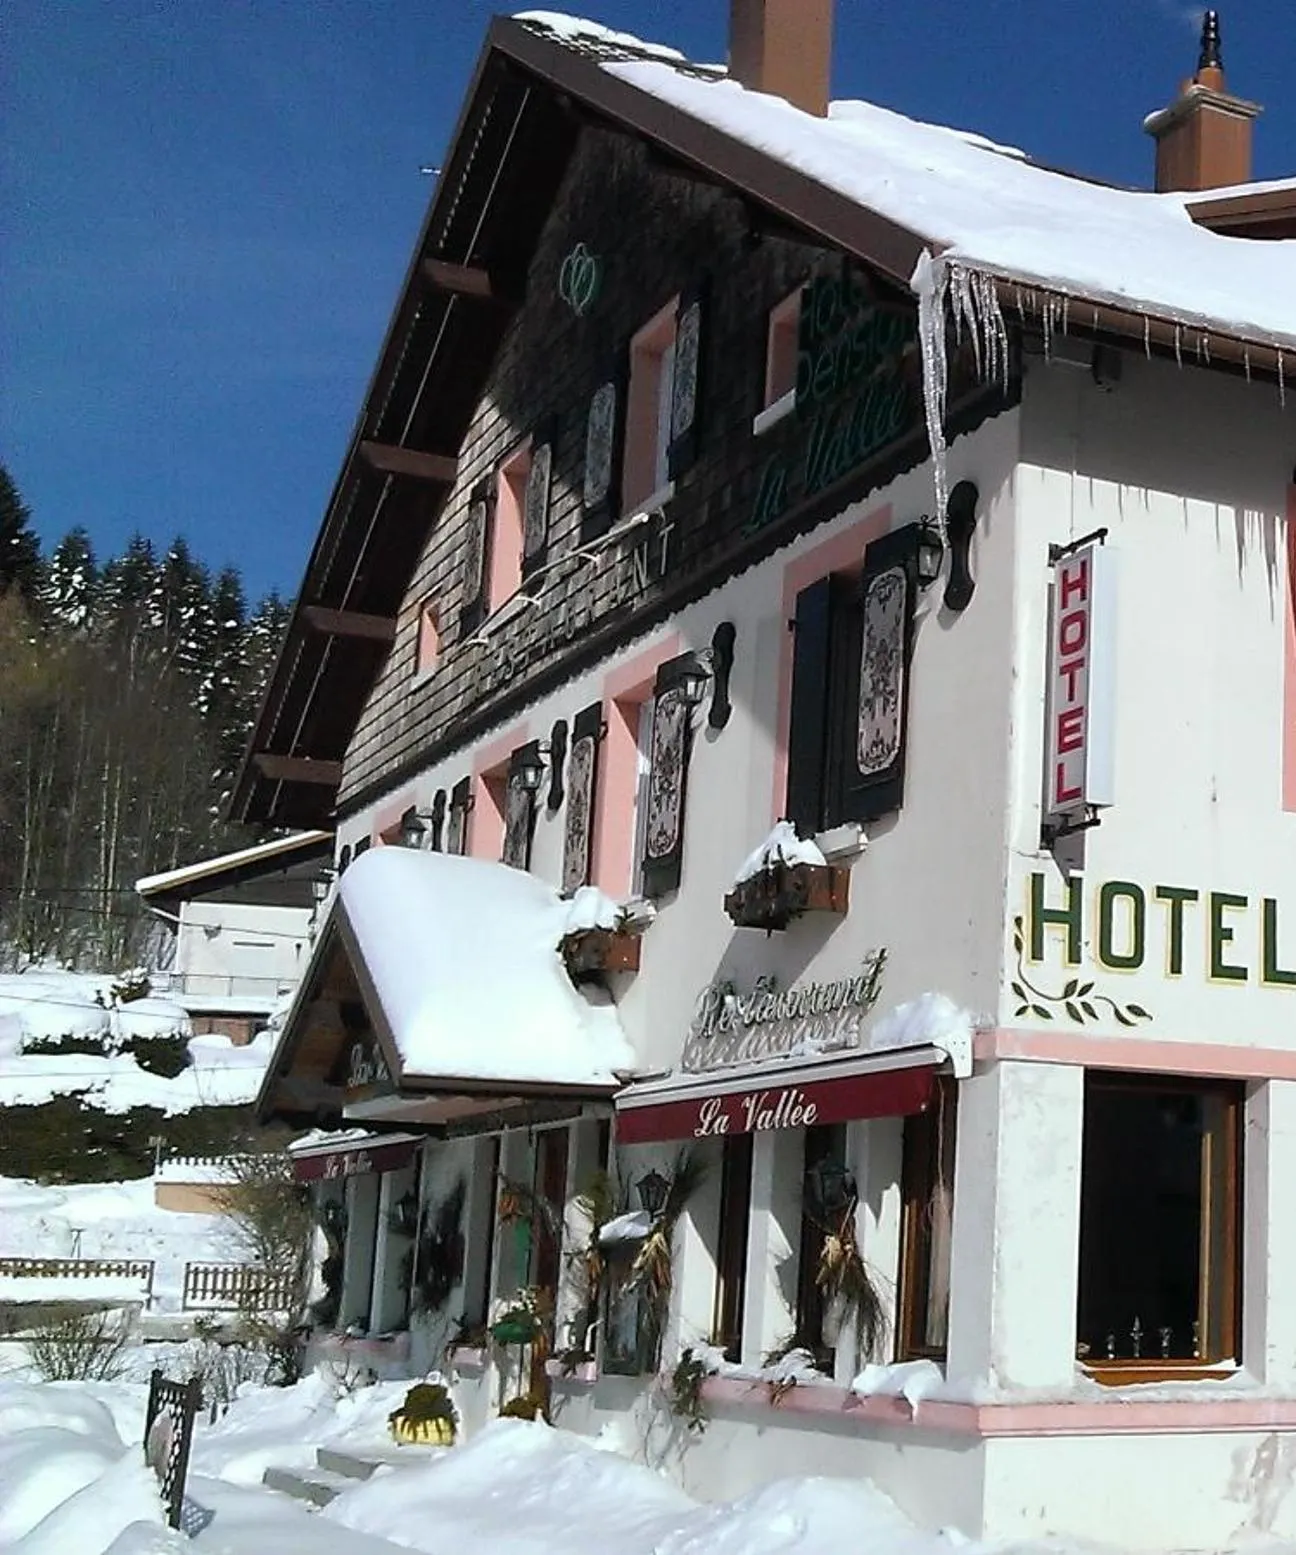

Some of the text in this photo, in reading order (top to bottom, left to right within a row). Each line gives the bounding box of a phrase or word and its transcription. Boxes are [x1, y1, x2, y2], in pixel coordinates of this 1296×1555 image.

[1056, 560, 1088, 804] HOTEL
[694, 1088, 819, 1138] La Vallée
